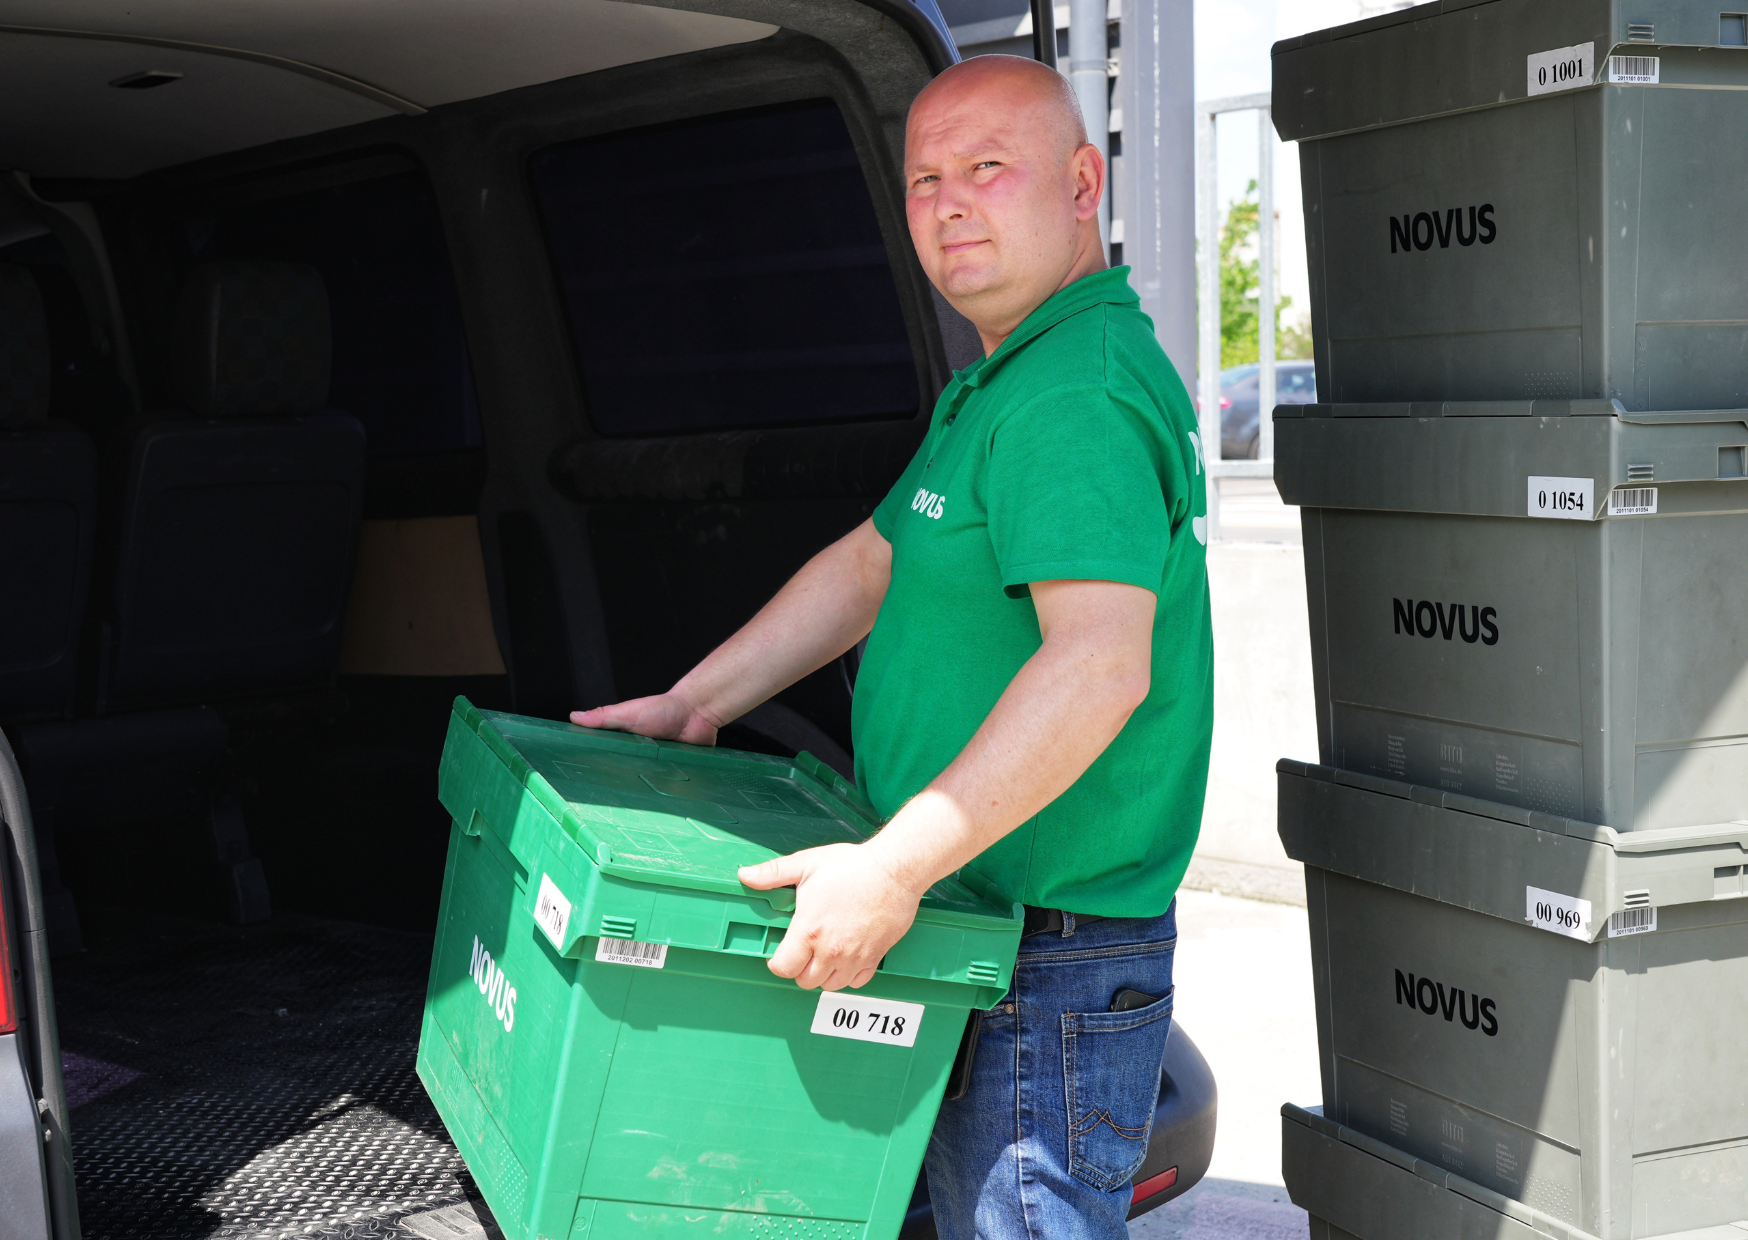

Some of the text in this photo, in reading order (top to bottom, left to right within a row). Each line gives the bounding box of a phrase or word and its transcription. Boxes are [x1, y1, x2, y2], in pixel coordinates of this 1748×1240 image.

[1538, 58, 1583, 86] 0 1001
[1389, 203, 1497, 254] NOVUS
[1538, 489, 1584, 511] 0 1054
[1392, 597, 1499, 646] NOVUS
[550, 905, 563, 935] 718
[1536, 901, 1581, 929] 00 969
[607, 954, 653, 966] 2011202 00718
[468, 933, 517, 1033] NOVUS
[1394, 967, 1499, 1037] NOVUS
[832, 1007, 906, 1036] 00 718
